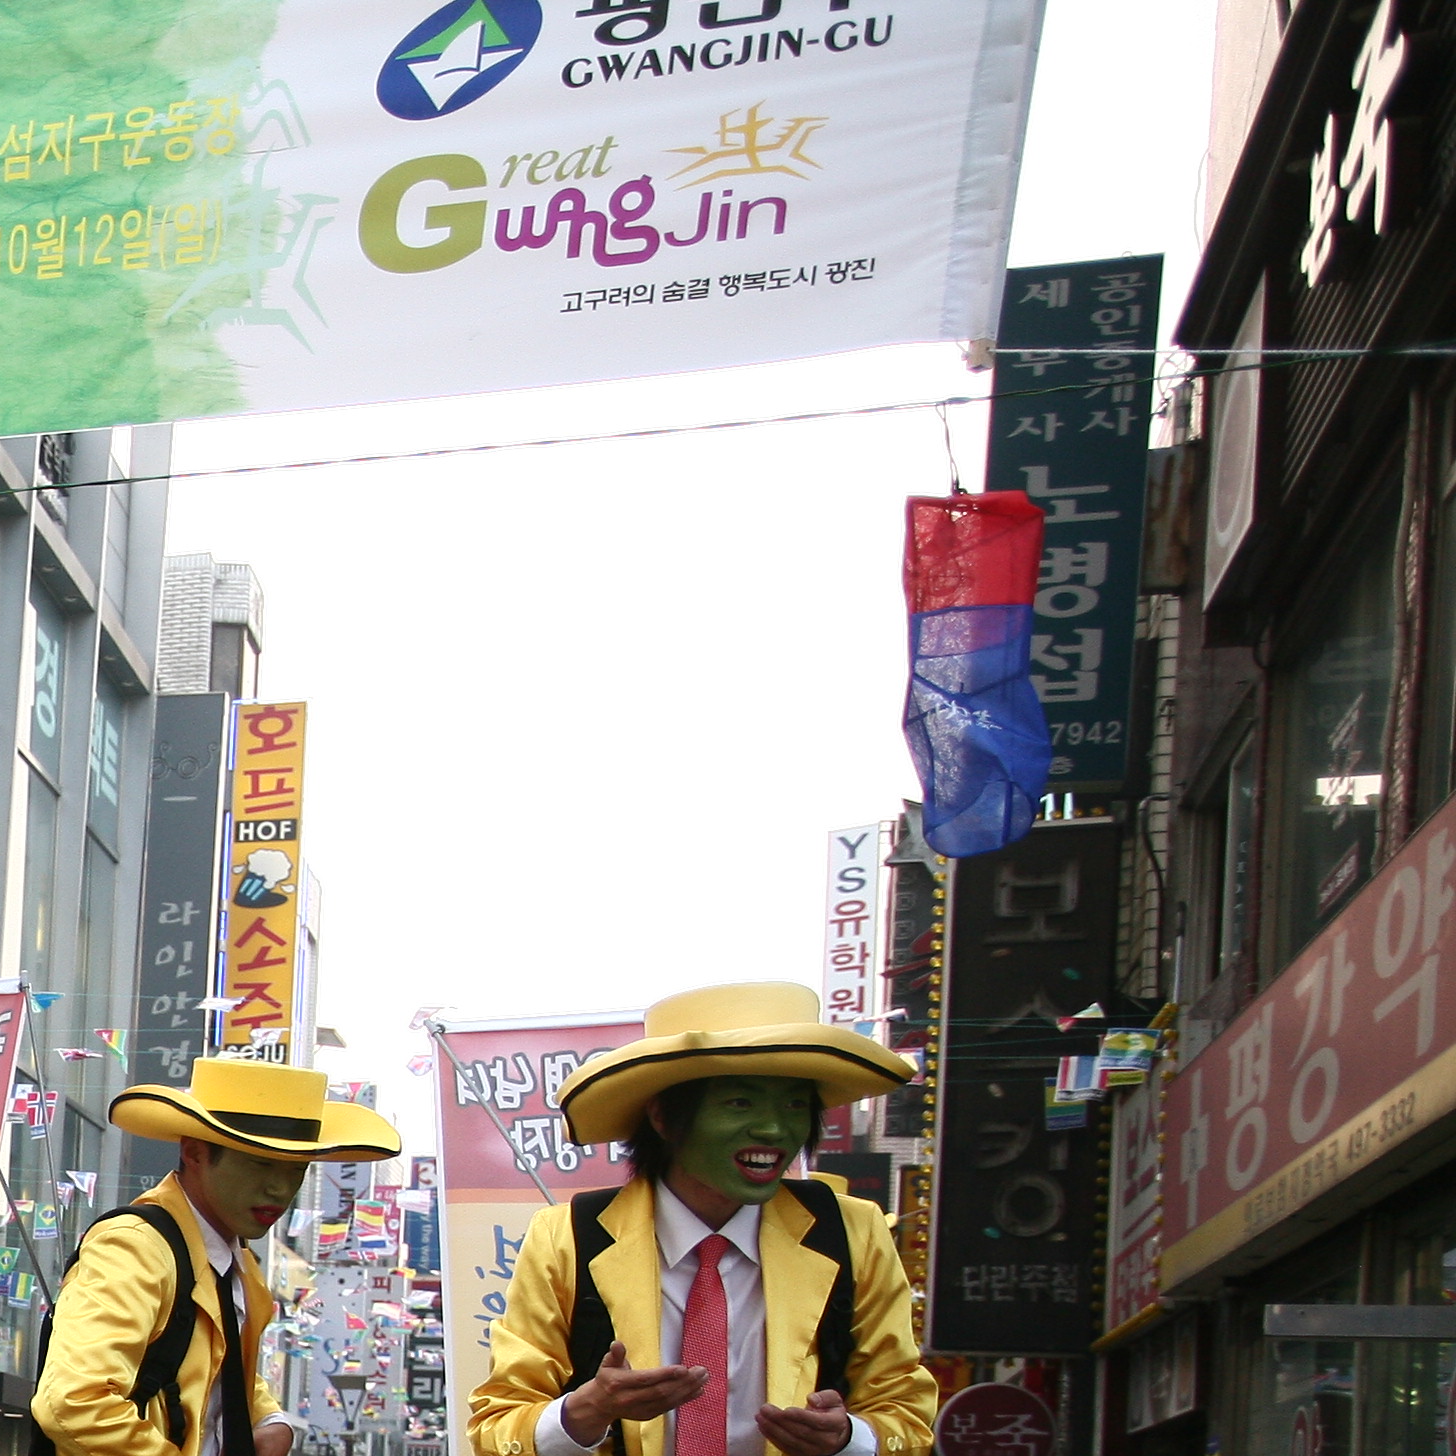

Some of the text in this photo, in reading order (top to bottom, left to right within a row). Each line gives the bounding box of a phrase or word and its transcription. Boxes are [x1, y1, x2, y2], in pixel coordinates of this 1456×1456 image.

[560, 14, 896, 90] GWANGJIN-GU
[559, 256, 878, 315] 고구려의 숨결 행복도시 광진
[242, 705, 298, 816] 호프
[237, 821, 293, 843] HOF
[148, 900, 201, 1079] 라인안경
[960, 1263, 1079, 1303] 단란주점
